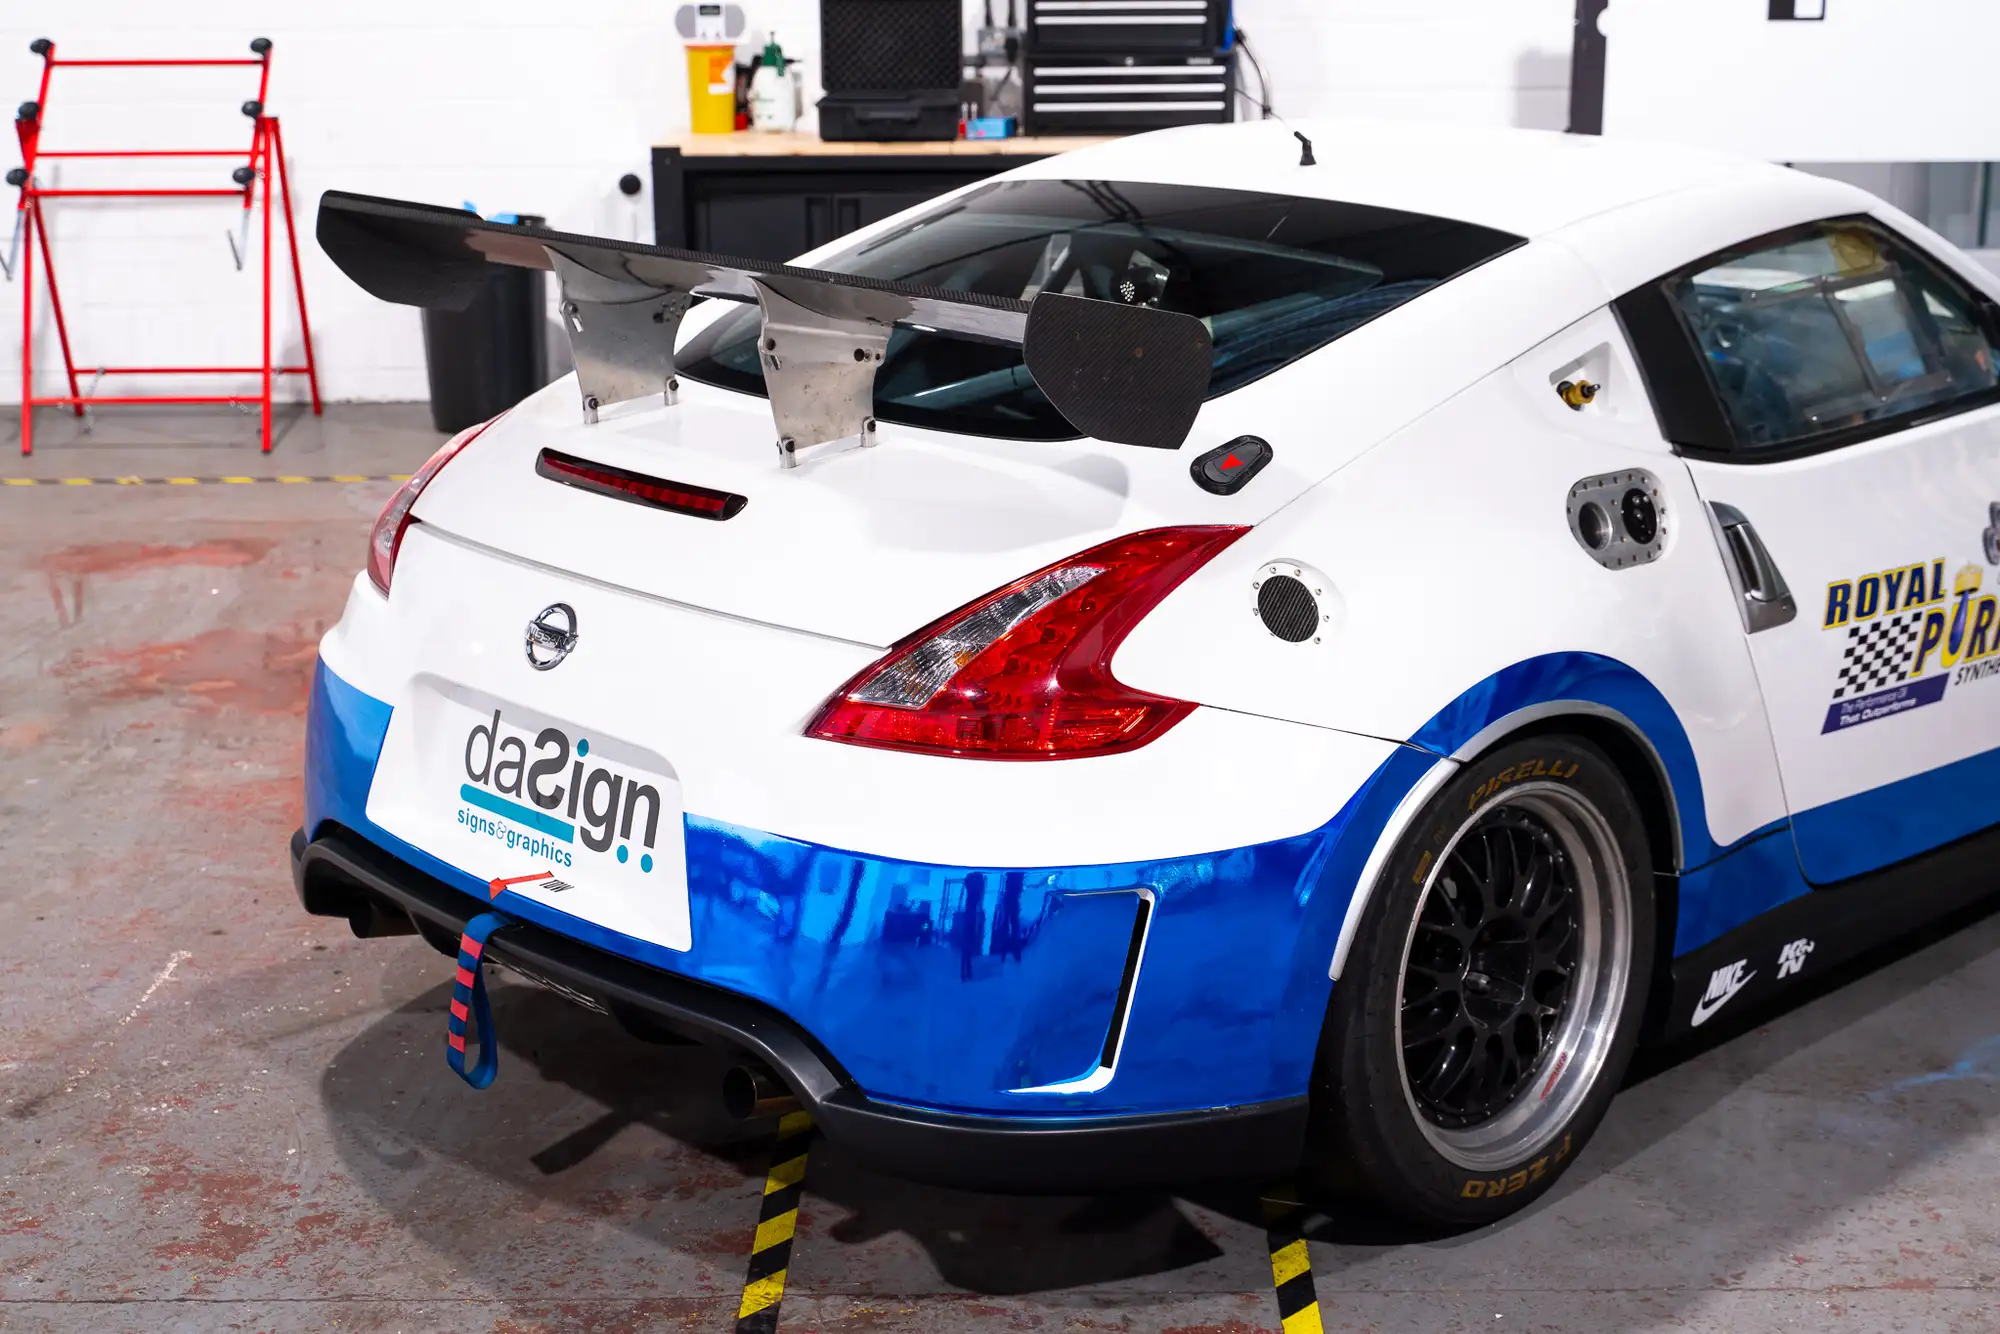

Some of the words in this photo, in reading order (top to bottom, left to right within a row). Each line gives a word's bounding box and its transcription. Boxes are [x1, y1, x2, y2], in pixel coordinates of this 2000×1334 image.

[1822, 557, 1947, 631] ROYAL
[525, 626, 569, 648] NISSAN
[1467, 758, 1579, 812] PIRELLI
[1704, 958, 1748, 1002] NIKE
[1460, 1156, 1549, 1198] ZERO
